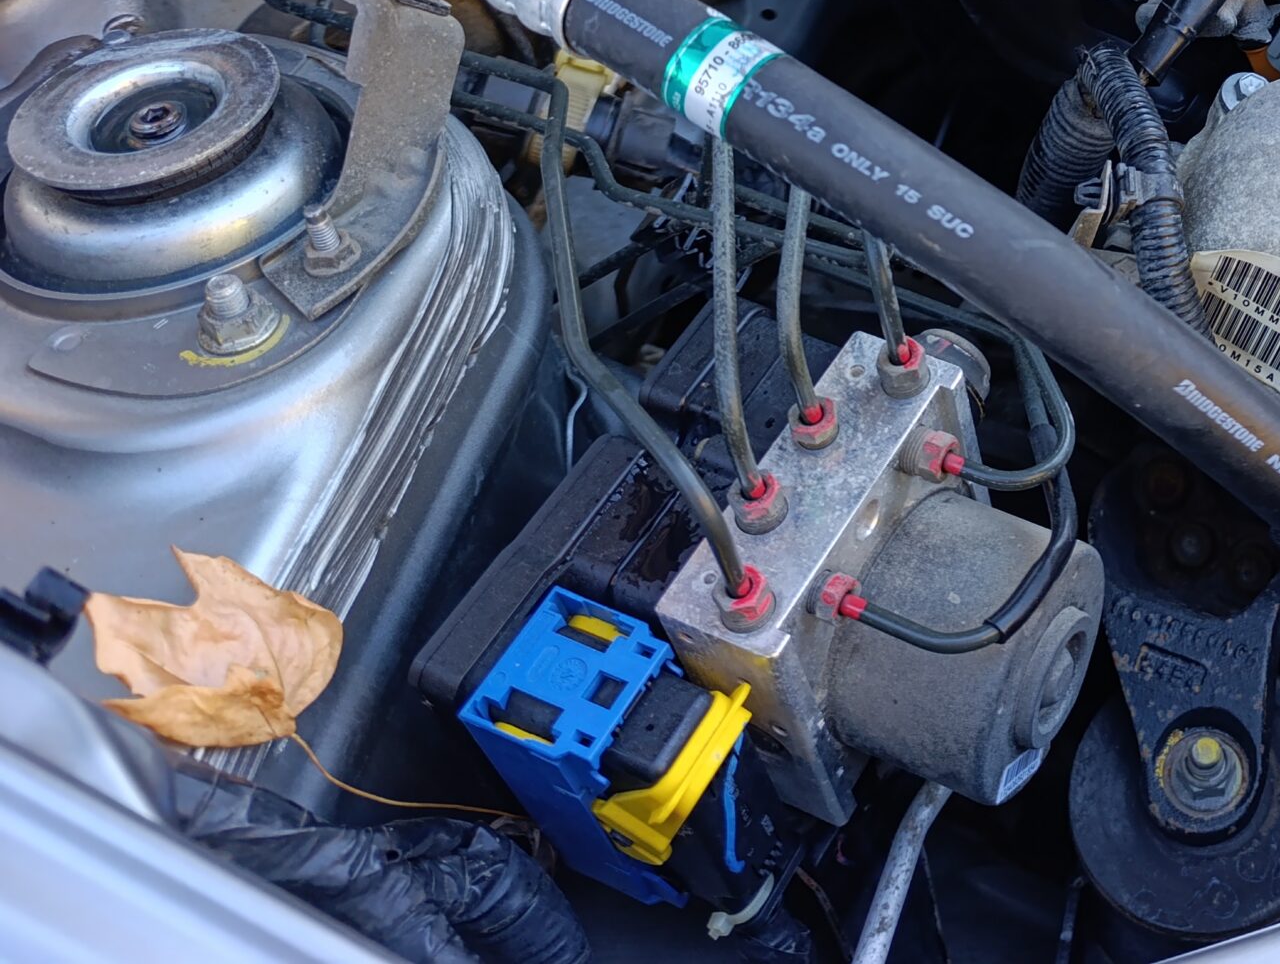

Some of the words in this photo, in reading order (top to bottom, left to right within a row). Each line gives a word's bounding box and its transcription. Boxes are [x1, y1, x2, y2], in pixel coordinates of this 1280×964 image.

[831, 143, 890, 182] ONLY
[895, 184, 922, 204] 15
[927, 204, 974, 239] SUC
[1173, 379, 1265, 452] BRIDGESTONE
